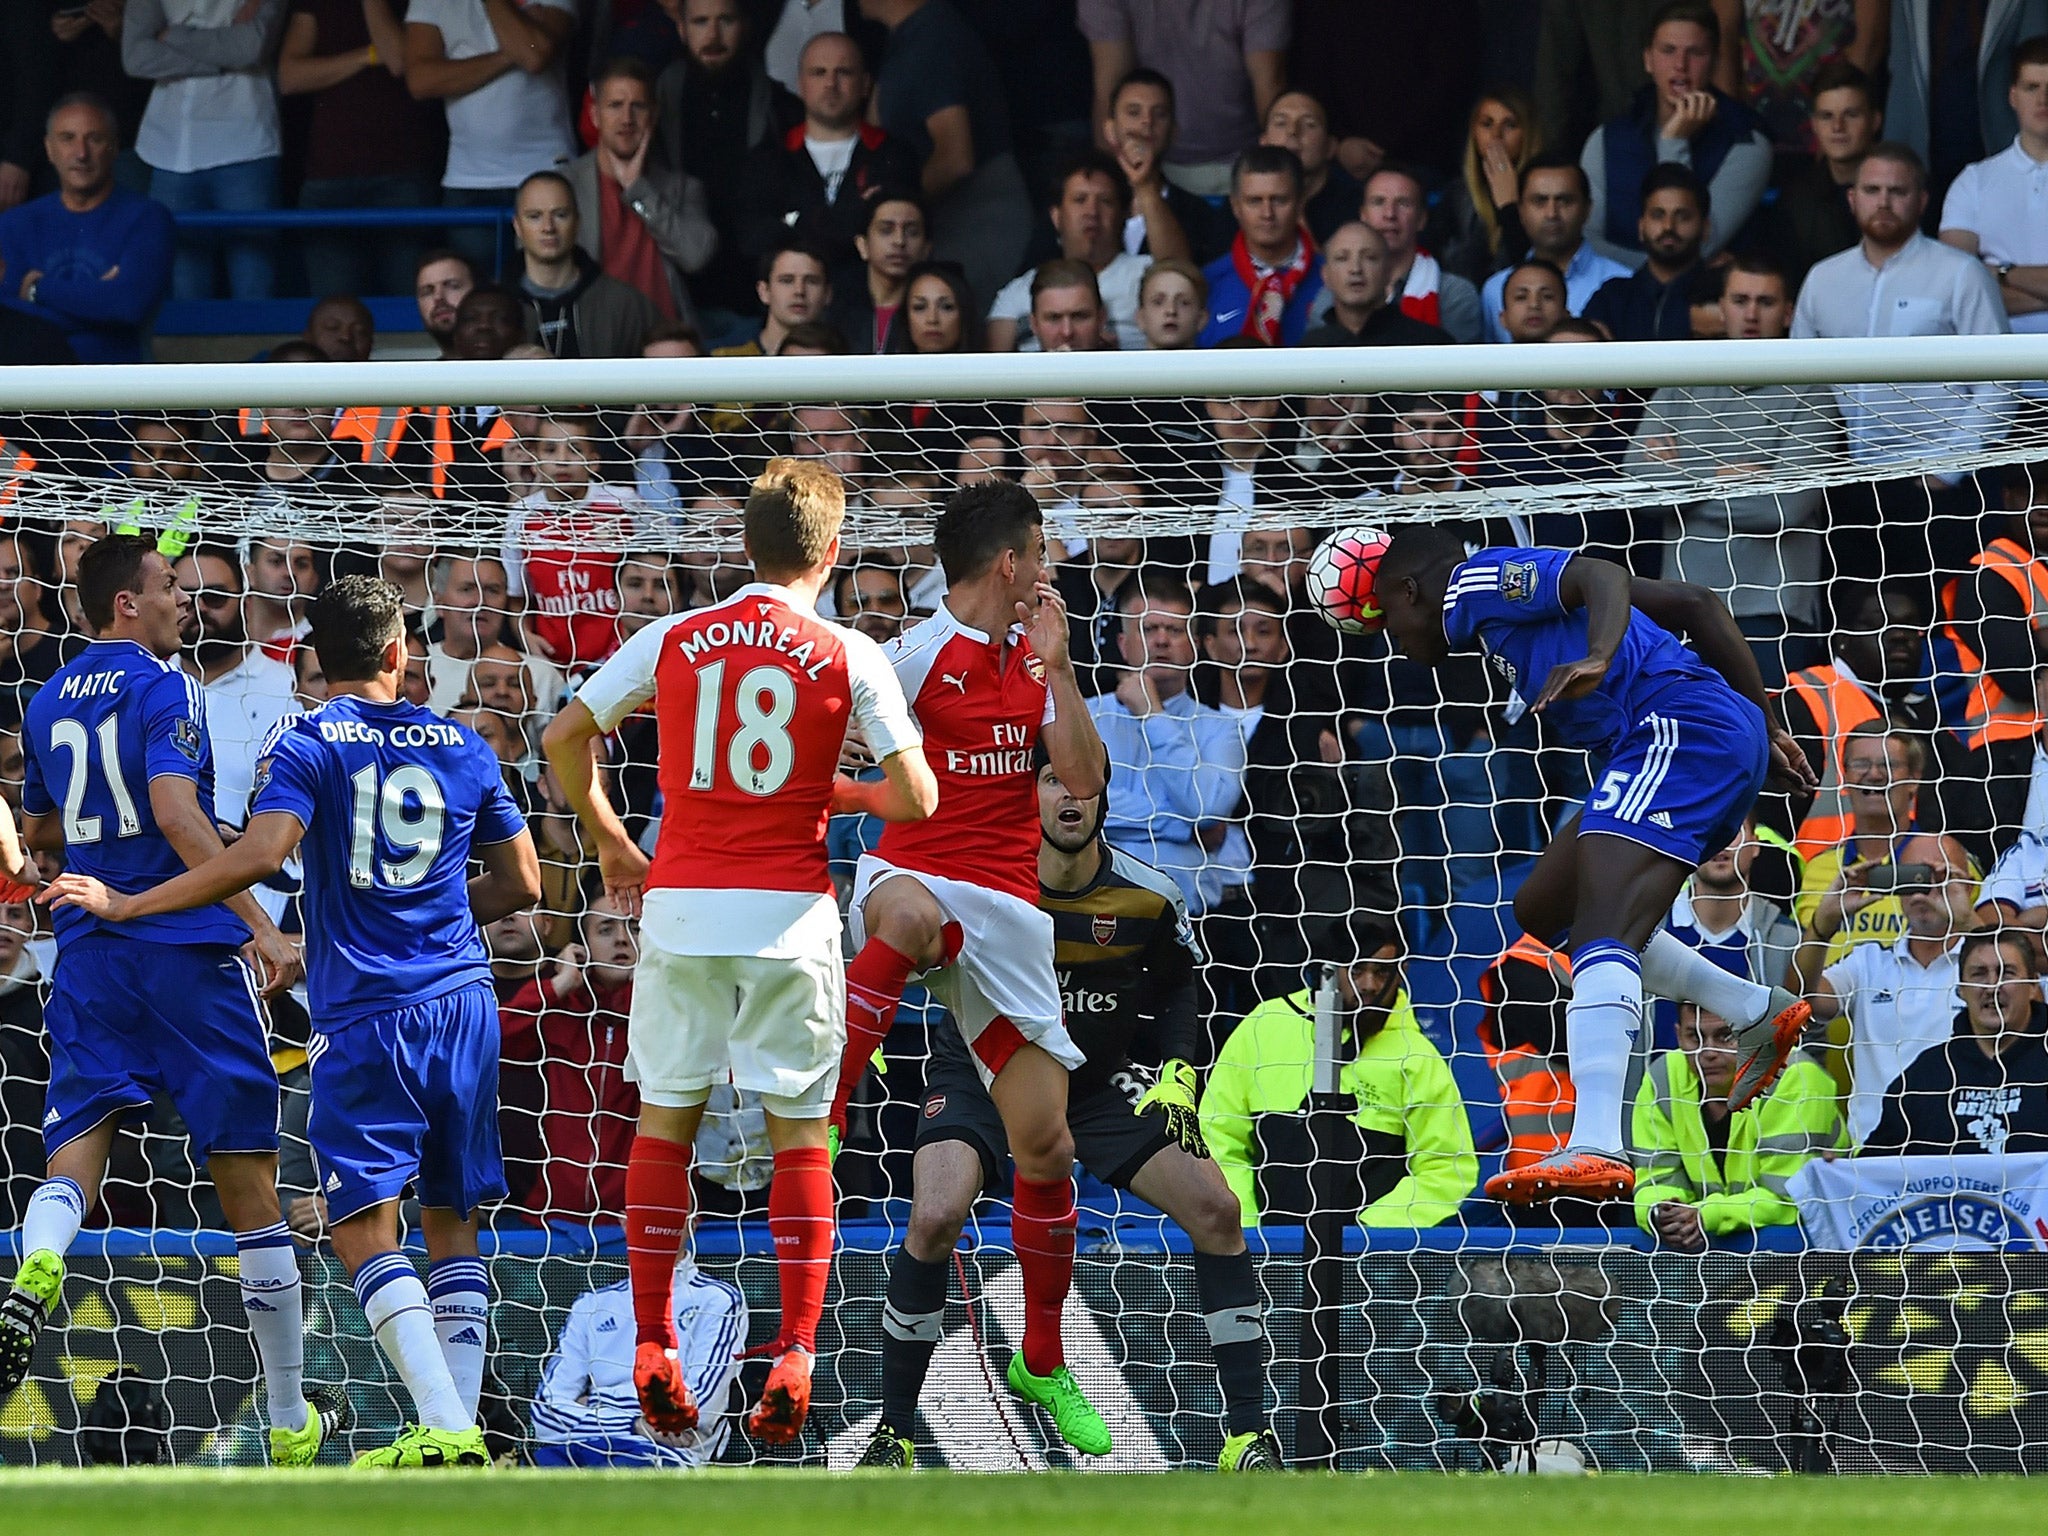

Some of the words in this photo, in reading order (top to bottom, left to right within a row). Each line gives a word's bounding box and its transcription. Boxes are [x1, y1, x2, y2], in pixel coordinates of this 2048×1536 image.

[534, 588, 618, 614] mirate
[679, 620, 831, 682] MONREAL
[59, 670, 125, 699] MATIC
[319, 721, 384, 748] DIEGO
[390, 724, 464, 747] COSTA
[688, 658, 797, 796] 18
[992, 723, 1027, 747] Fly
[50, 712, 142, 845] 21
[946, 747, 1034, 776] Emirat
[1592, 769, 1631, 811] 5
[350, 762, 445, 888] 19
[1061, 988, 1118, 1013] ates
[1108, 1071, 1147, 1107] 3
[1848, 1191, 1900, 1239] OFFICIAL
[1906, 1176, 1999, 1198] SUPPORTERS
[2002, 1190, 2031, 1215] CLUB
[1872, 1203, 2009, 1252] CHELSEA
